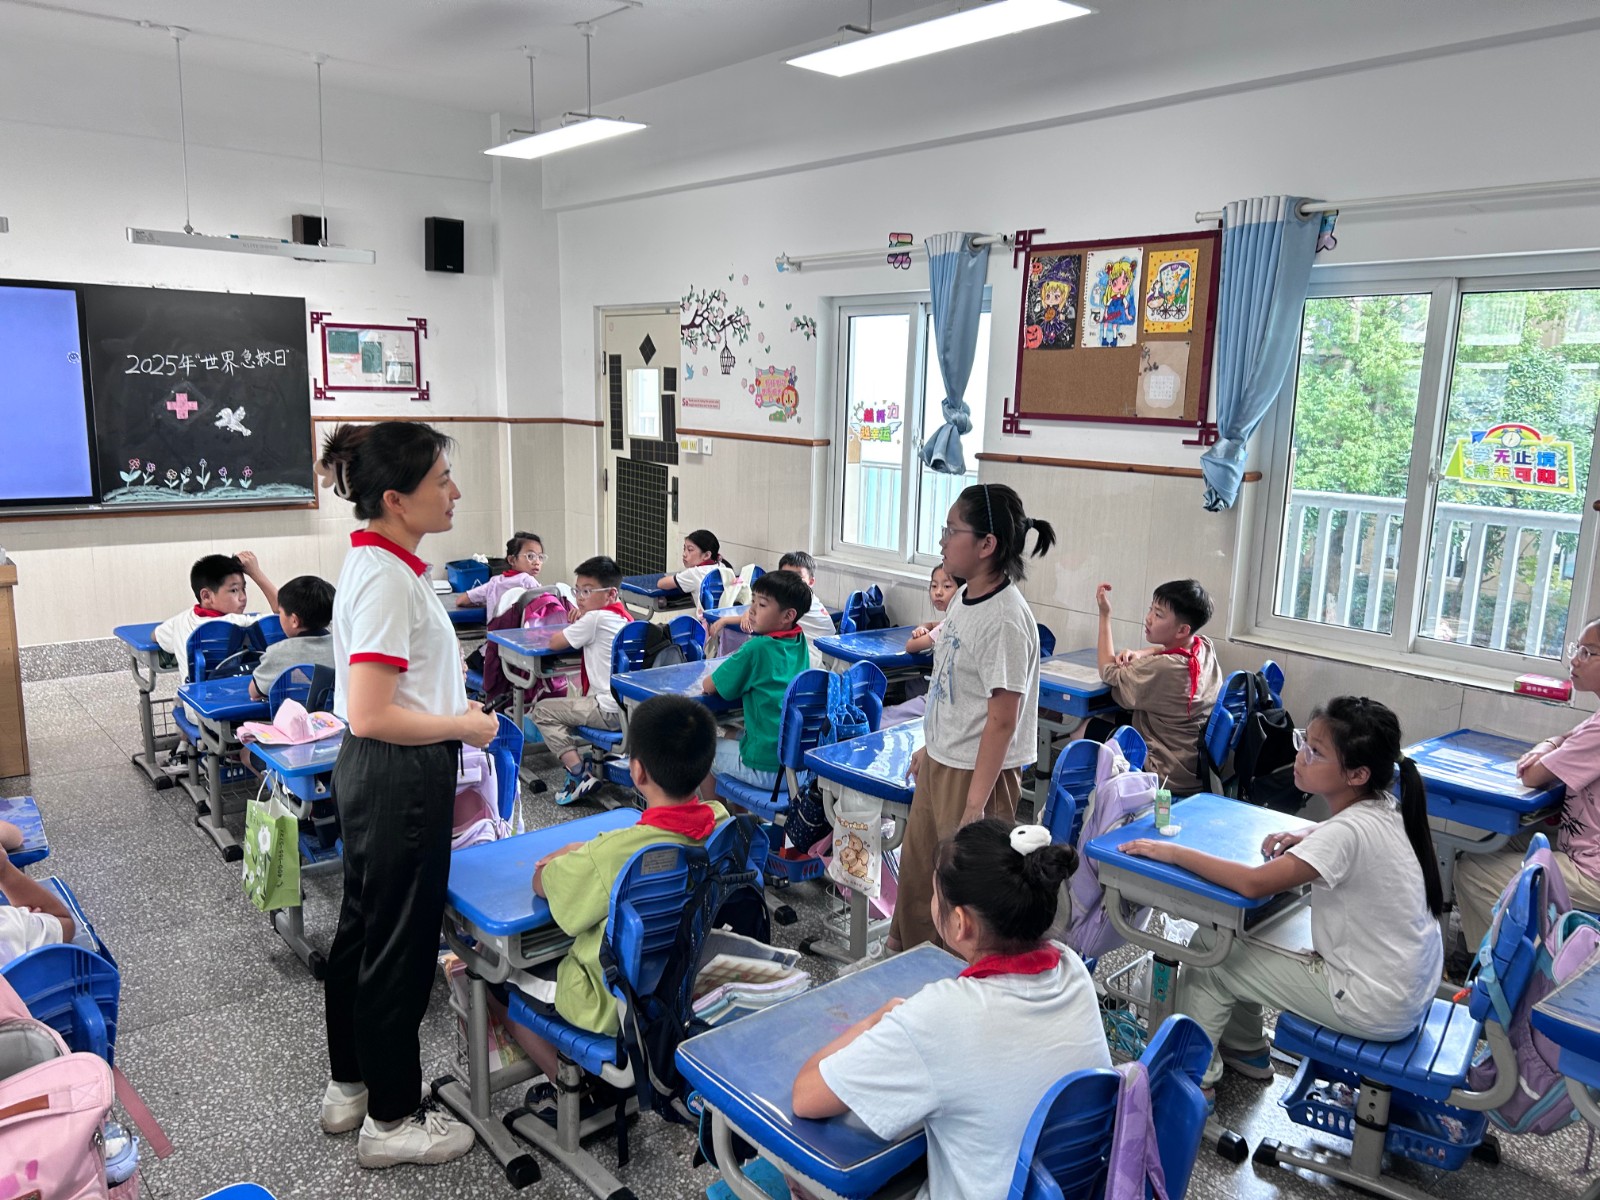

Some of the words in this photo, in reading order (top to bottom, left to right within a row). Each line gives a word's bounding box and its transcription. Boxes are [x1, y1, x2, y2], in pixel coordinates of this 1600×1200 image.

[1473, 448, 1557, 467] 学无止境
[1473, 465, 1557, 484] 未来可期
